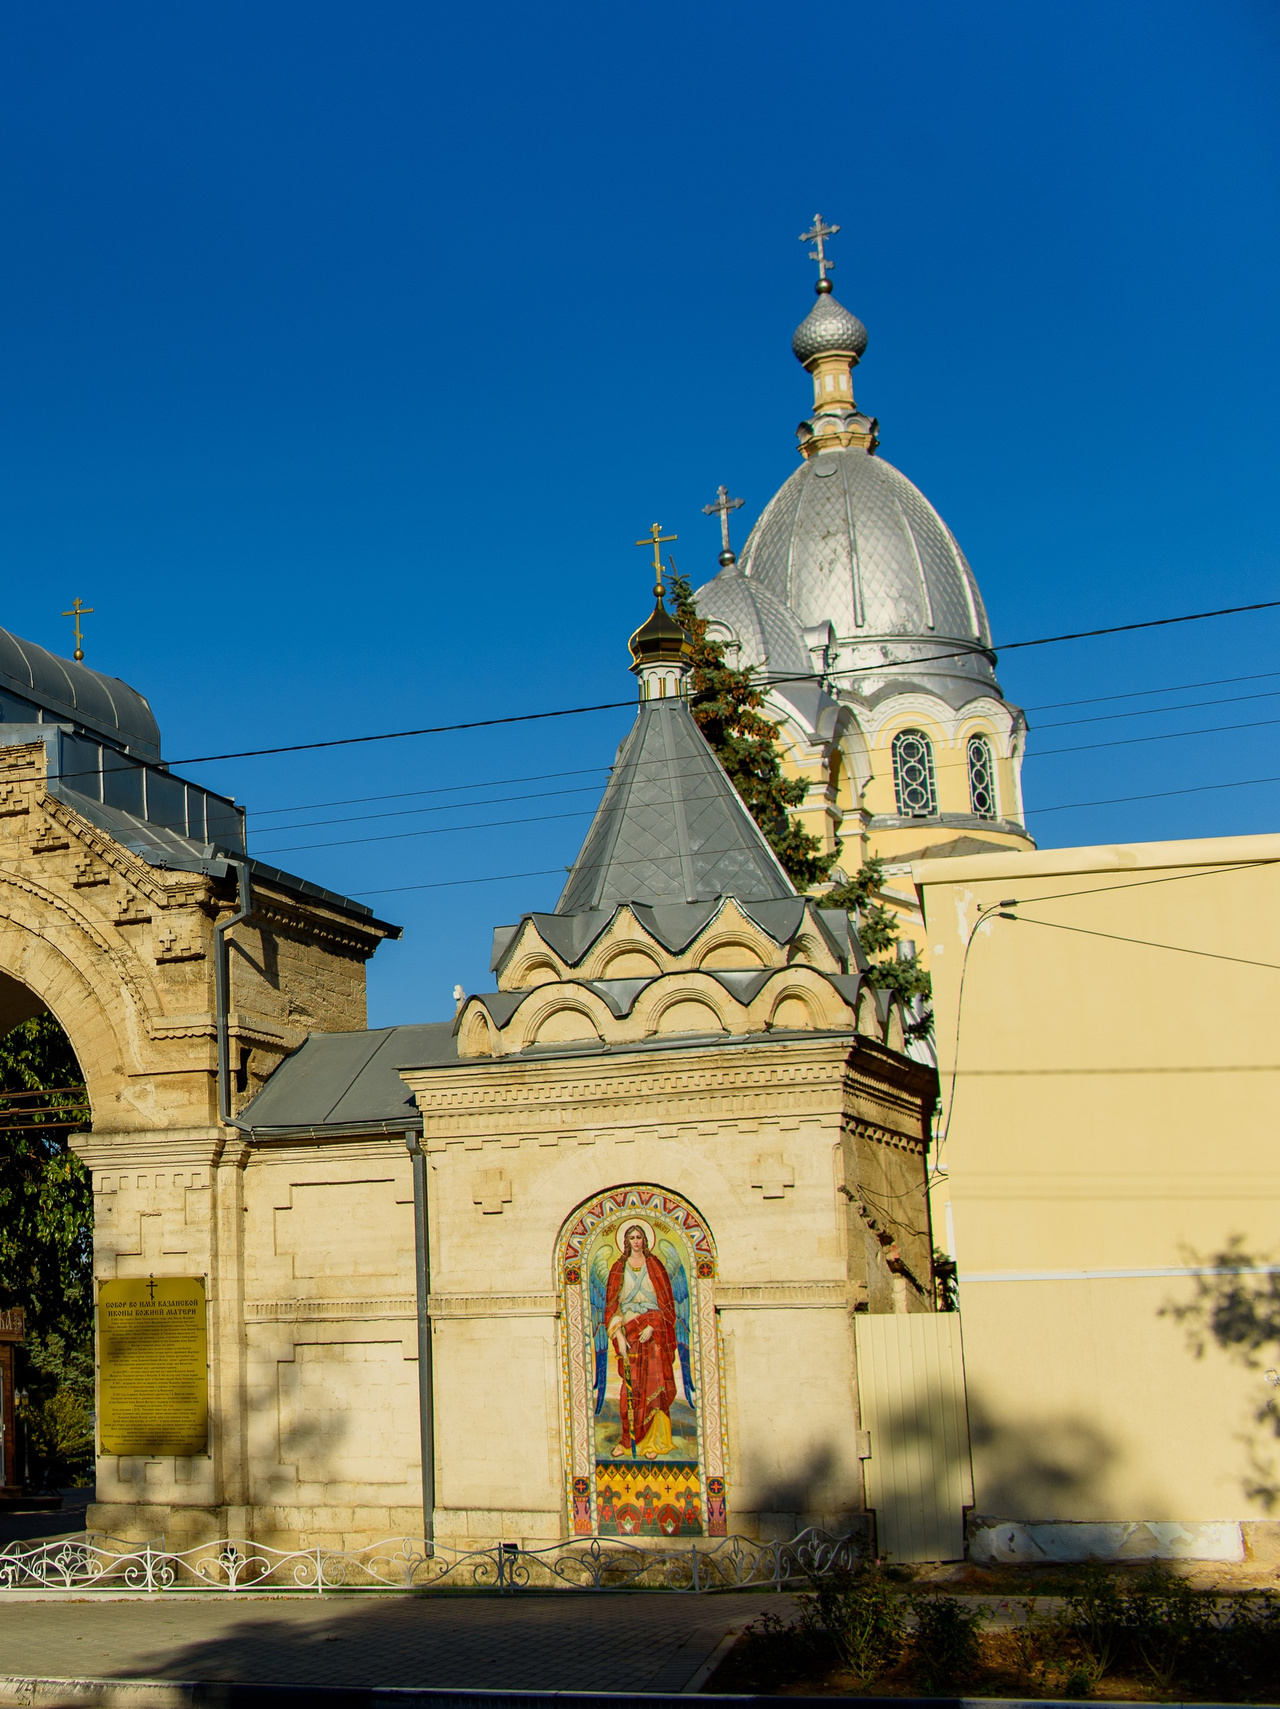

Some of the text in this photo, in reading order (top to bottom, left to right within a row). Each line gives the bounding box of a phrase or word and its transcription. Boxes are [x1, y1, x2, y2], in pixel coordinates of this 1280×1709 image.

[158, 1299, 198, 1307] КАЗАНСКОЙ
[135, 1308, 164, 1316] БОЖИЕЙ
[166, 1308, 196, 1316] МАТЕРИ
